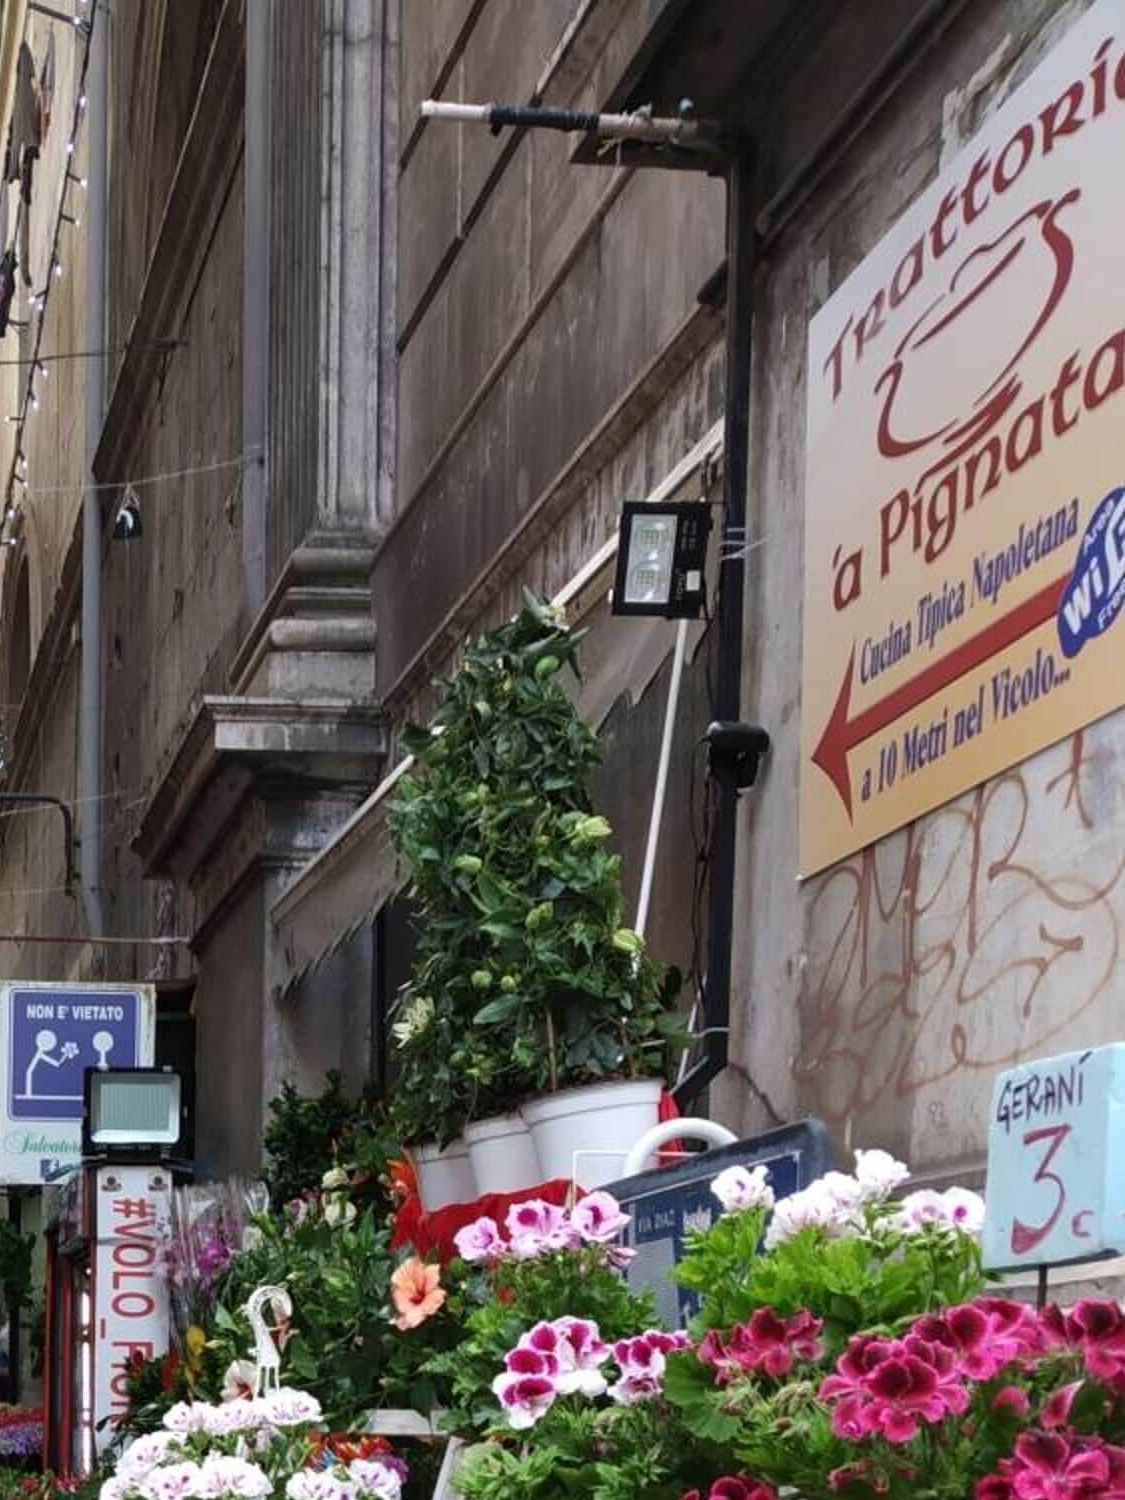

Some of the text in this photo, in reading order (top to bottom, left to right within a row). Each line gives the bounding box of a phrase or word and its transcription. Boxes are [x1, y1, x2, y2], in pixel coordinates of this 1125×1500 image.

[879, 330, 1125, 578] Pignata
[860, 622, 912, 685] Cucina
[917, 579, 965, 648] Tipica
[971, 497, 1079, 608] Napoletana
[861, 648, 1071, 801] a 10 Metri nel Vicolo...
[26, 1004, 54, 1019] NON
[72, 1005, 124, 1021] VIETATO
[1011, 1123, 1071, 1254] 3
